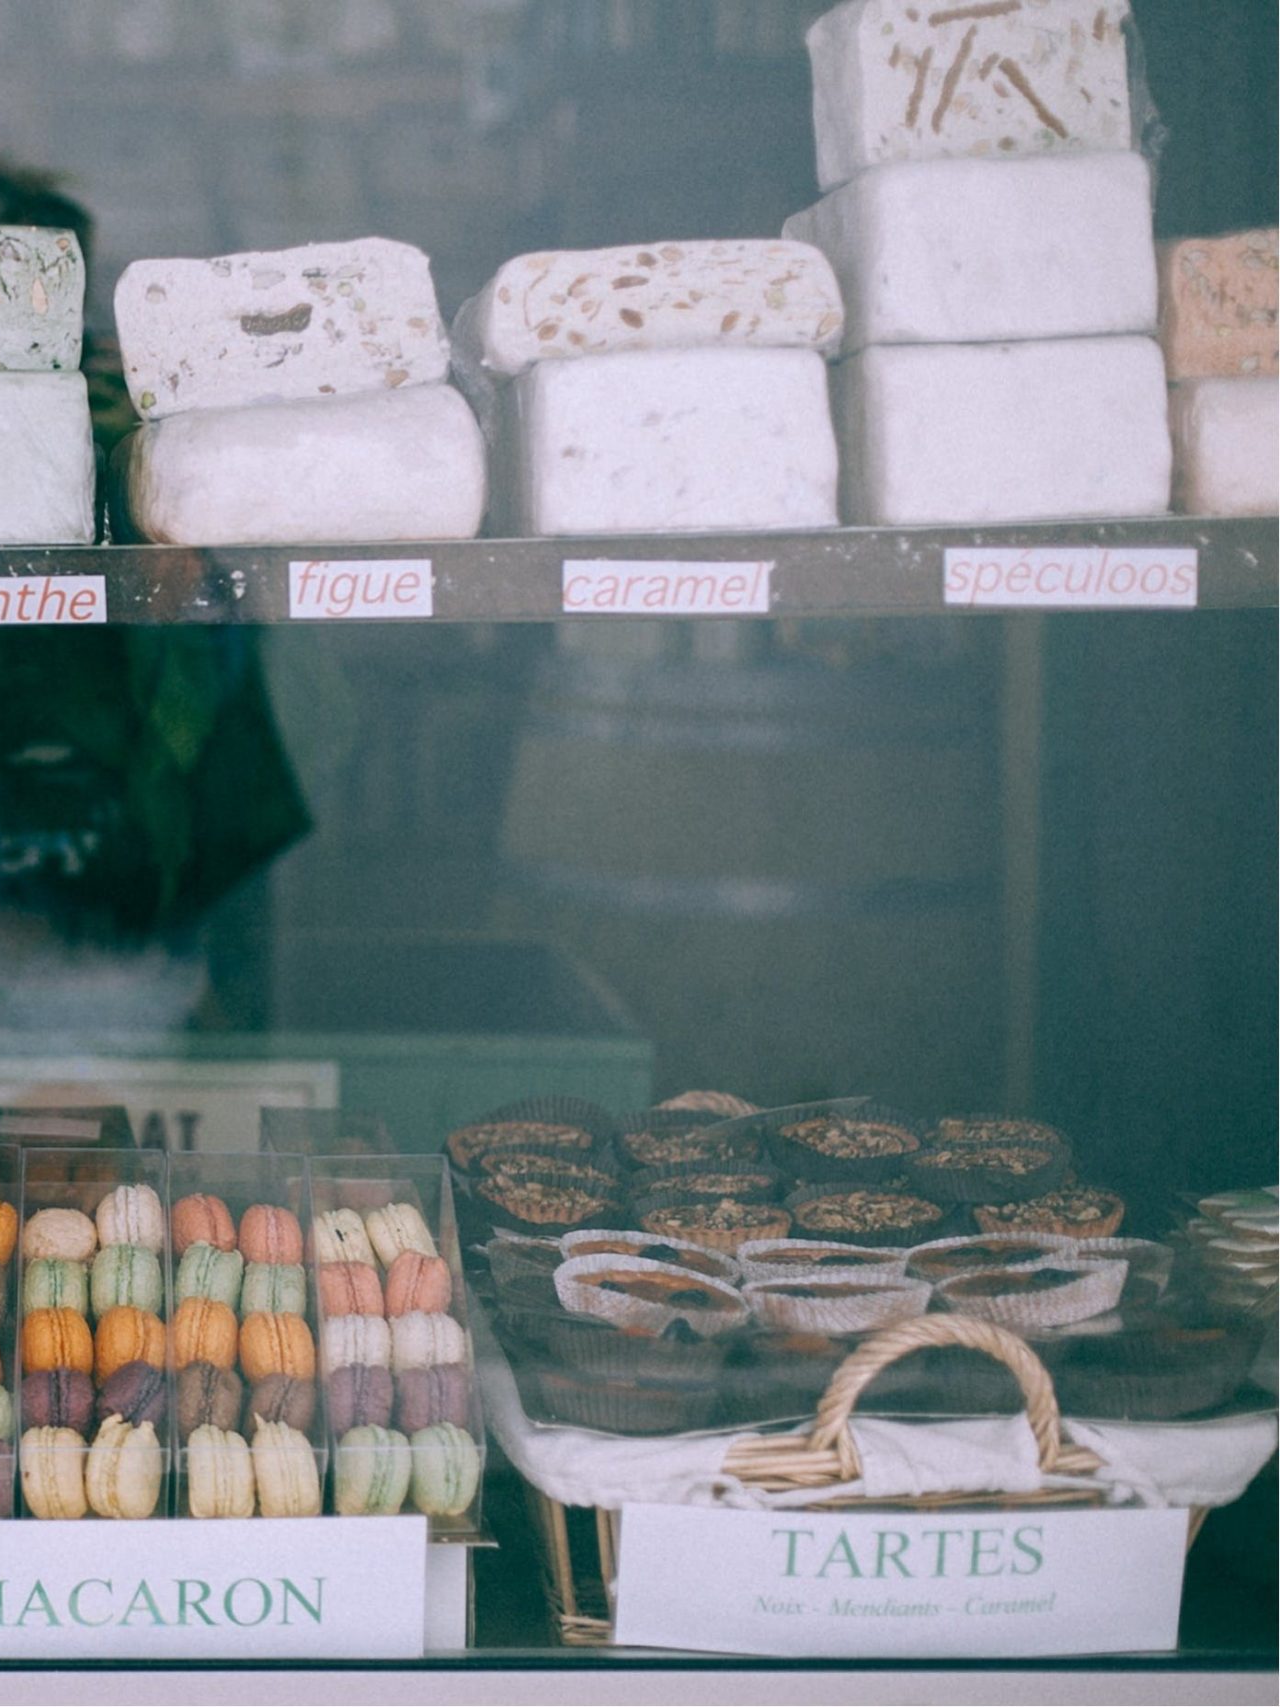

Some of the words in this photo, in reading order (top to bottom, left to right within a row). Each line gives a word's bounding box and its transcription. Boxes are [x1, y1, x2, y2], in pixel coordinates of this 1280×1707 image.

[296, 561, 421, 616] figue
[563, 562, 764, 607] caramel
[945, 550, 1195, 604] spéculoos
[771, 1526, 1044, 1579] TARTES
[752, 1596, 804, 1615] Noix
[828, 1597, 940, 1617] Mendiants
[964, 1592, 1057, 1615] Caramel
